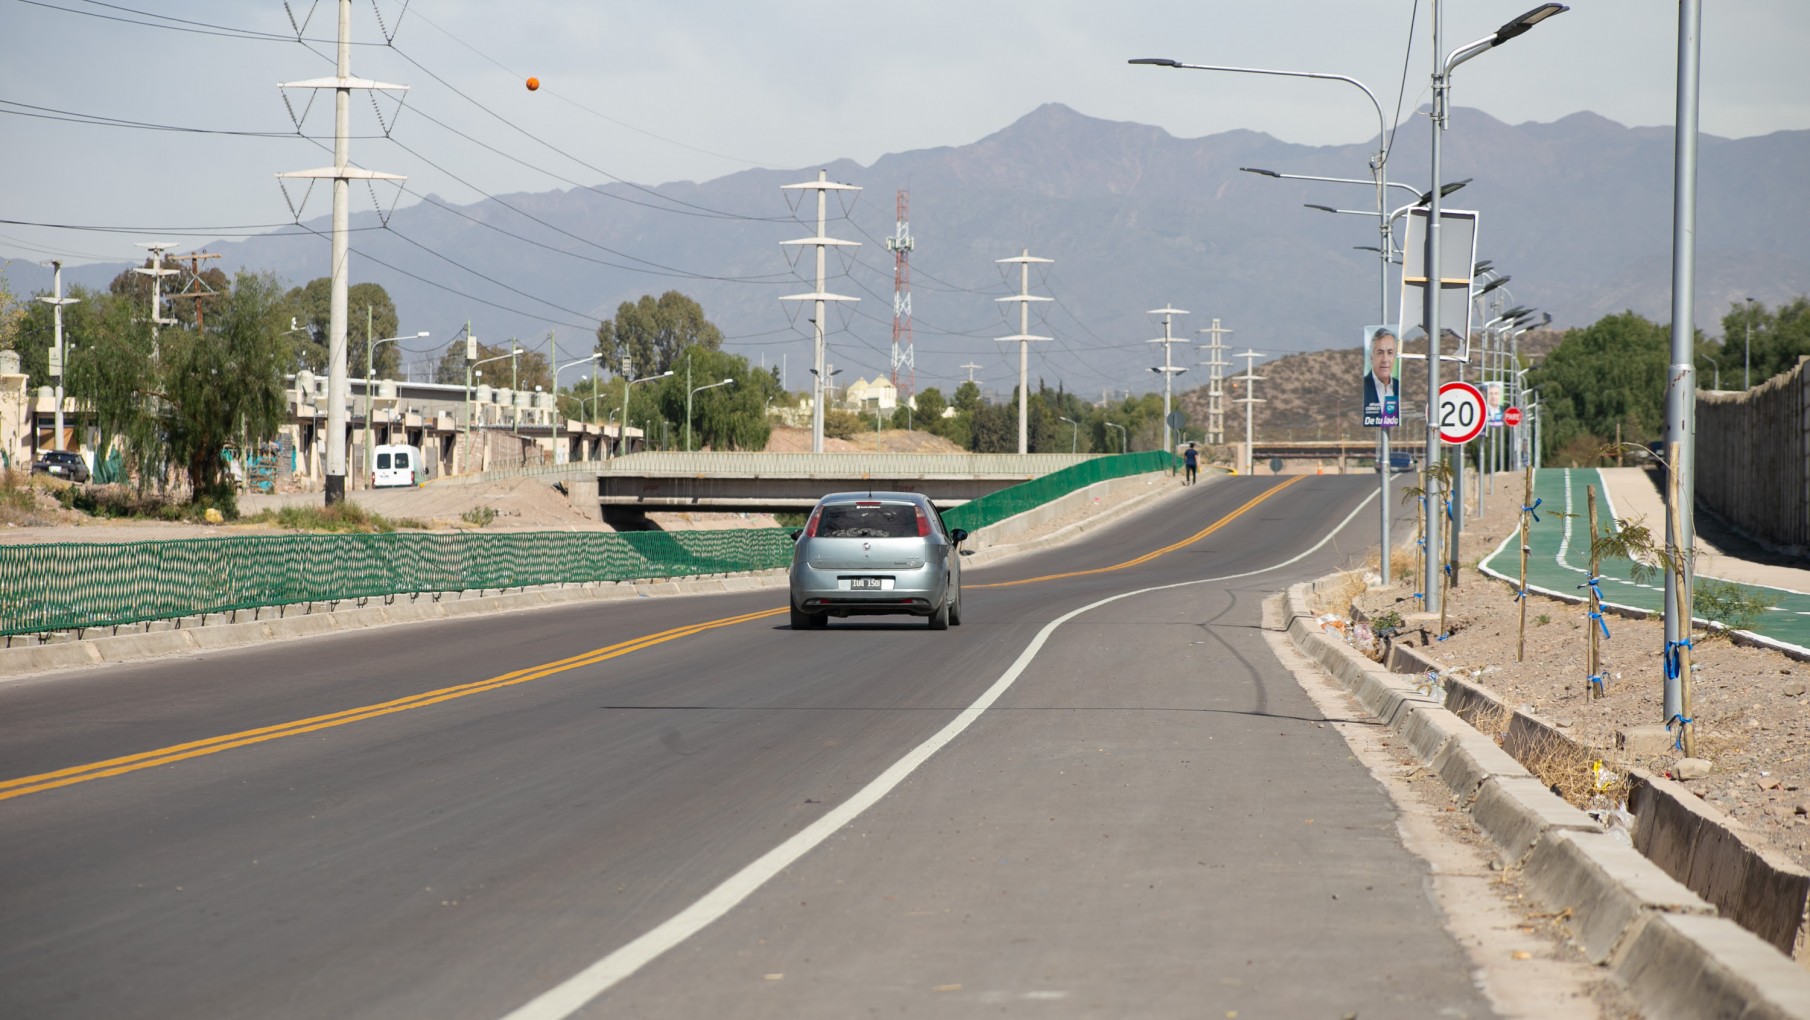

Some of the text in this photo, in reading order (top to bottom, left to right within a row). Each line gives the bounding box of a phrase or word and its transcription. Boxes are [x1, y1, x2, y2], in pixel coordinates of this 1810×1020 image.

[1364, 415, 1399, 426] De tu lado
[1441, 401, 1474, 427] 20
